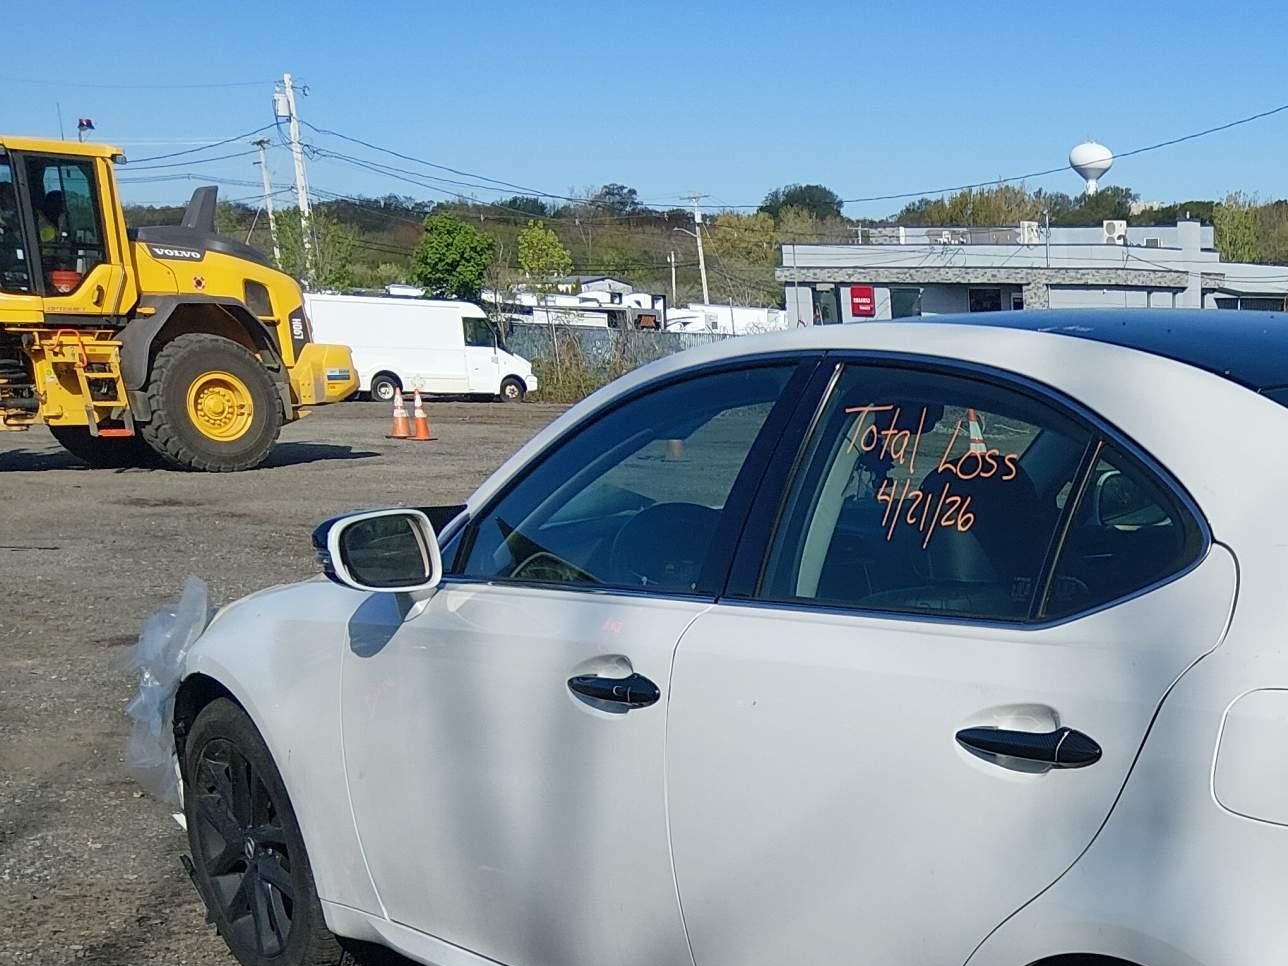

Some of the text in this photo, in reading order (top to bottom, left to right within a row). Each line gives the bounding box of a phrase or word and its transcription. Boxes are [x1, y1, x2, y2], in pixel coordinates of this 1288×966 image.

[152, 247, 201, 259] VOLVO
[845, 403, 927, 474] Total
[876, 478, 975, 550] 4/21/26
